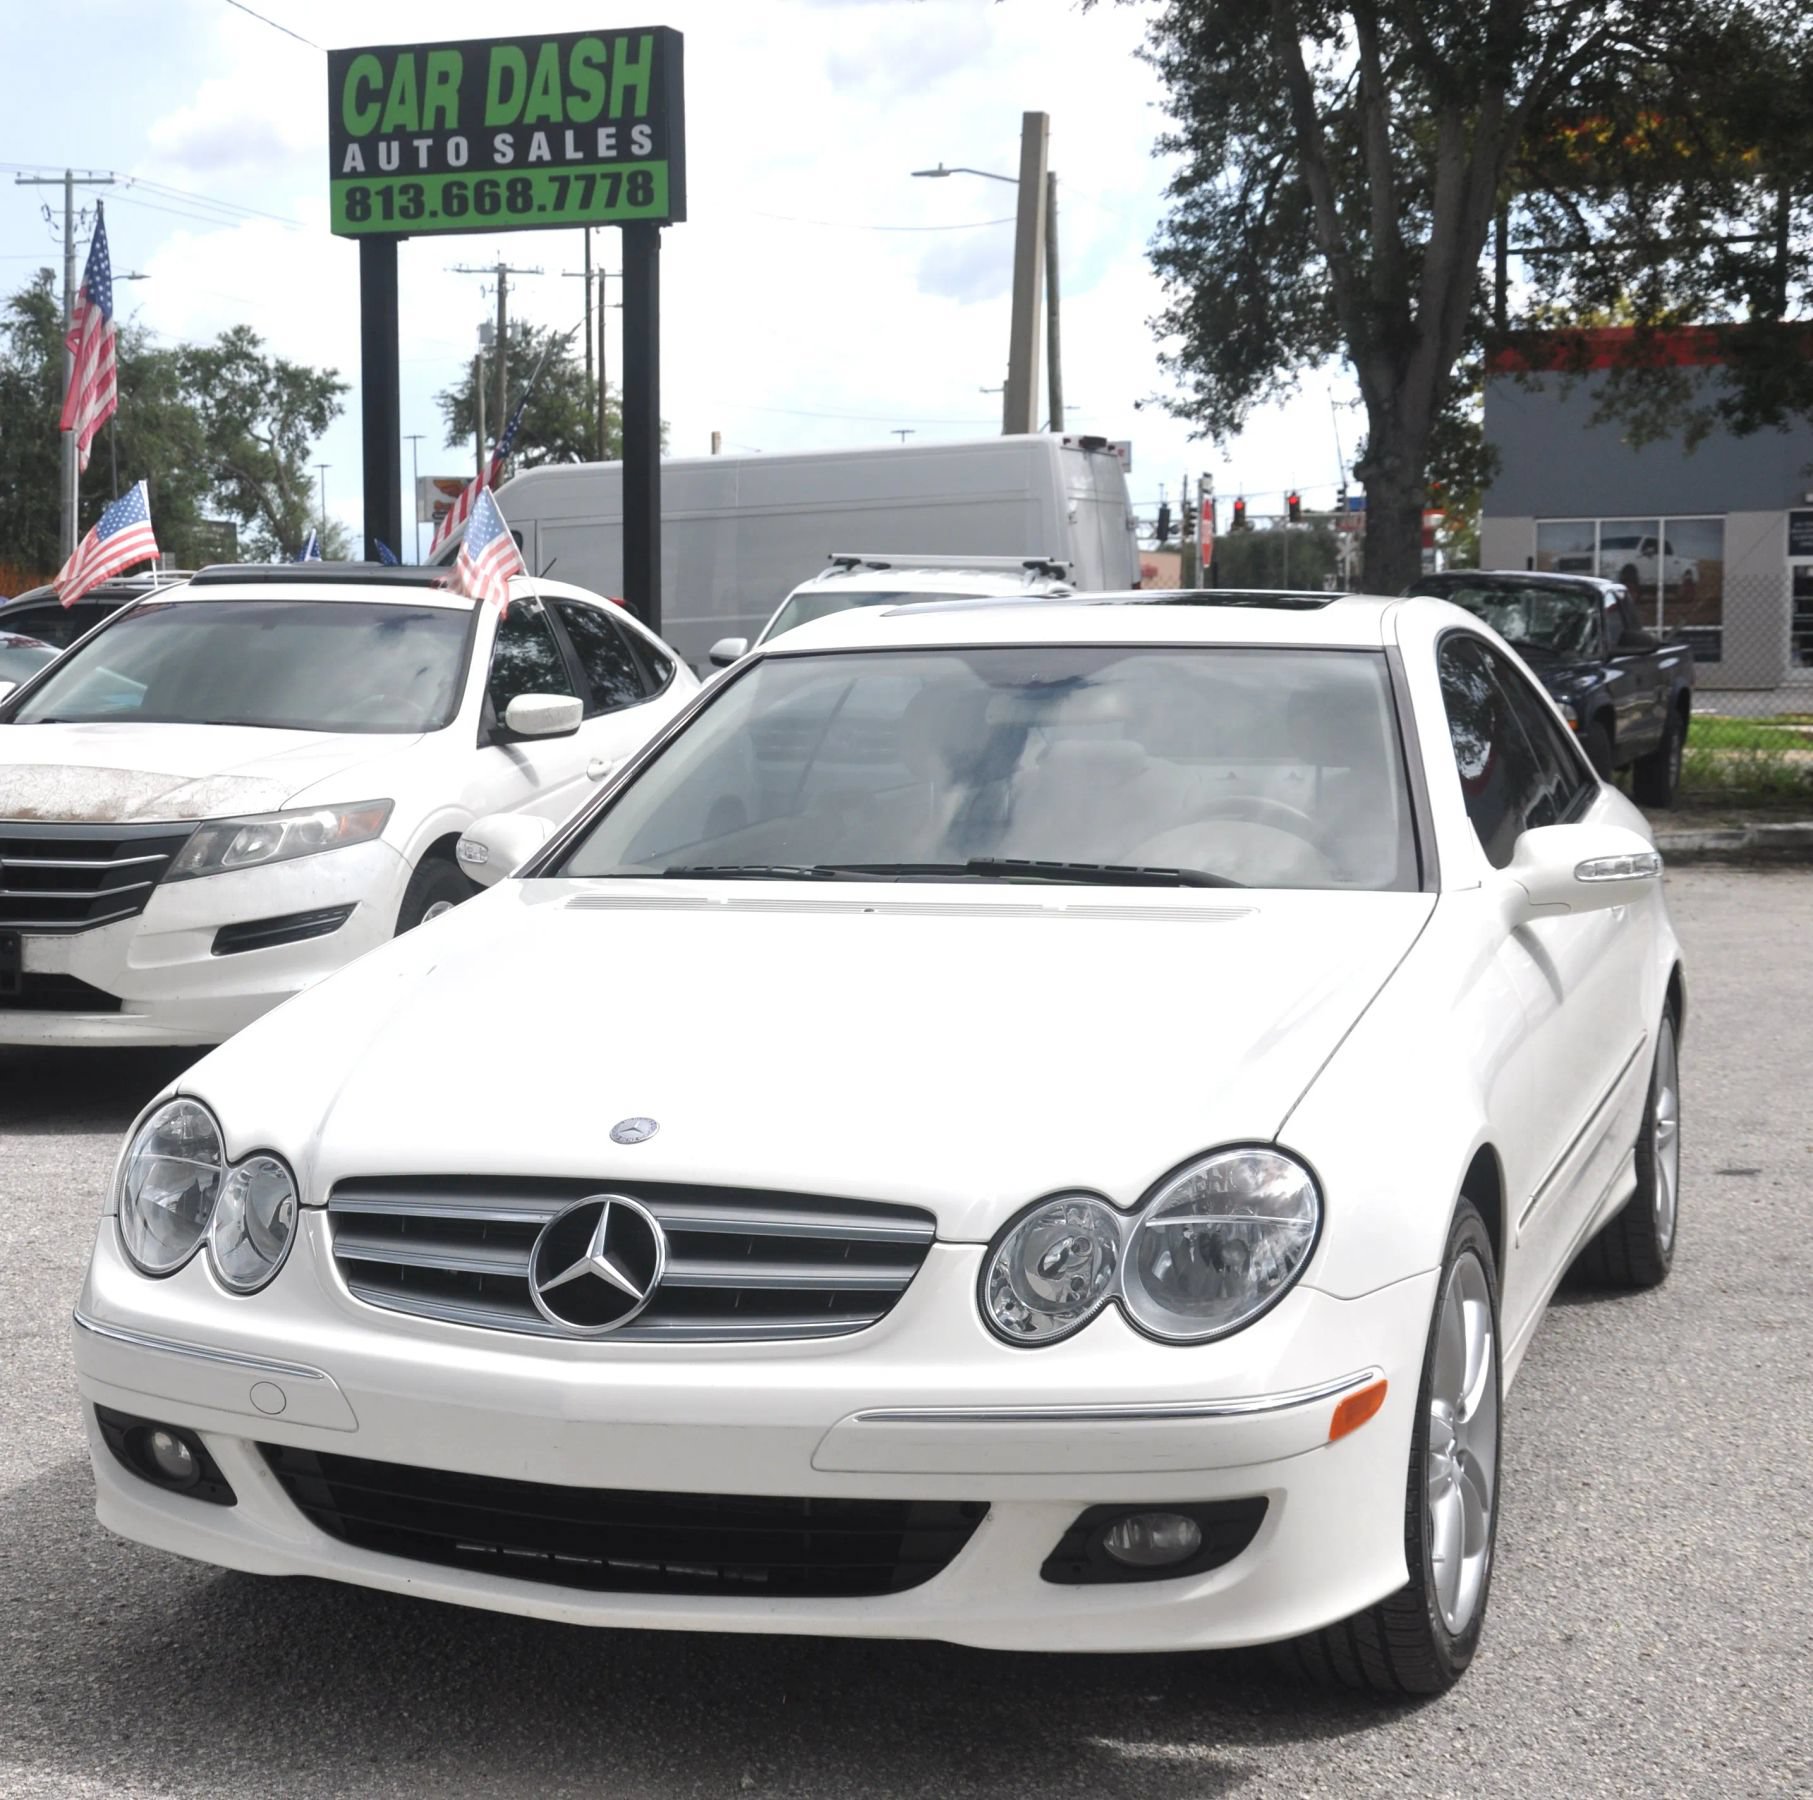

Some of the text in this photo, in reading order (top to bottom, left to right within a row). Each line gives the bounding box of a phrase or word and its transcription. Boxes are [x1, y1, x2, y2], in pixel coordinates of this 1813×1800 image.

[342, 35, 654, 137] CAR DASH
[343, 124, 653, 173] AUTO SALES
[345, 169, 655, 223] 813.668.7778
